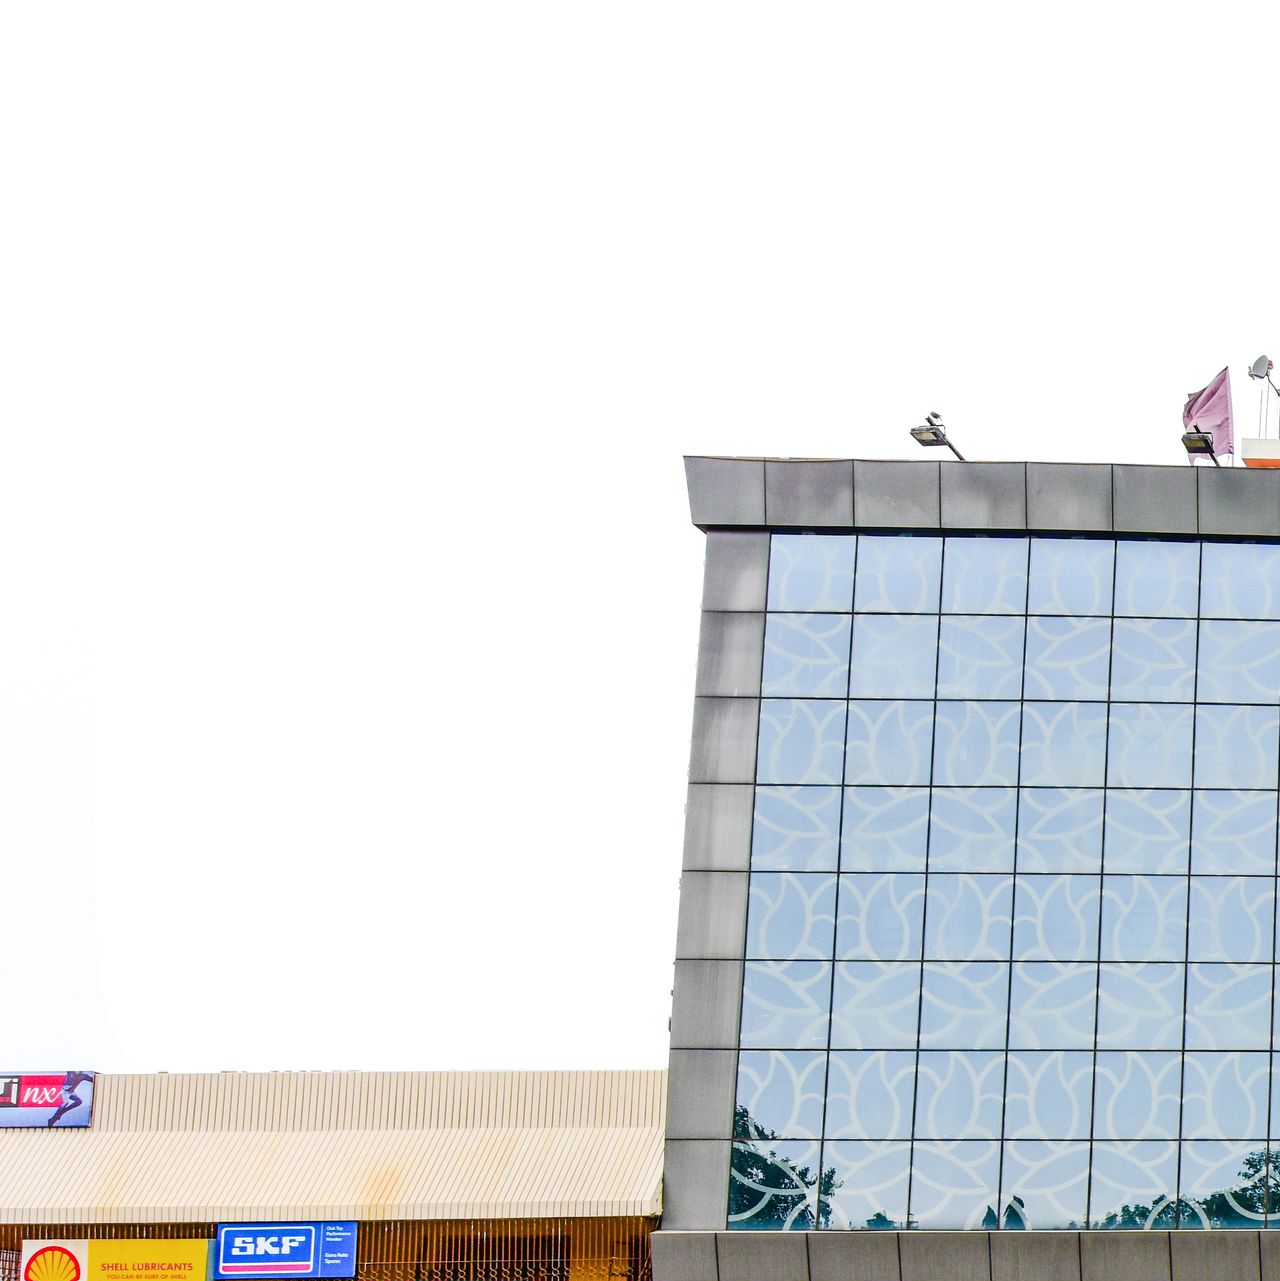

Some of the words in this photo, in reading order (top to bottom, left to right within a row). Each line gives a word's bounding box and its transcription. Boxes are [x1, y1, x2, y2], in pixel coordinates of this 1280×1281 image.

[231, 1236, 306, 1256] SKF
[101, 1263, 128, 1271] SHELL
[132, 1263, 193, 1271] LUBRICANTS
